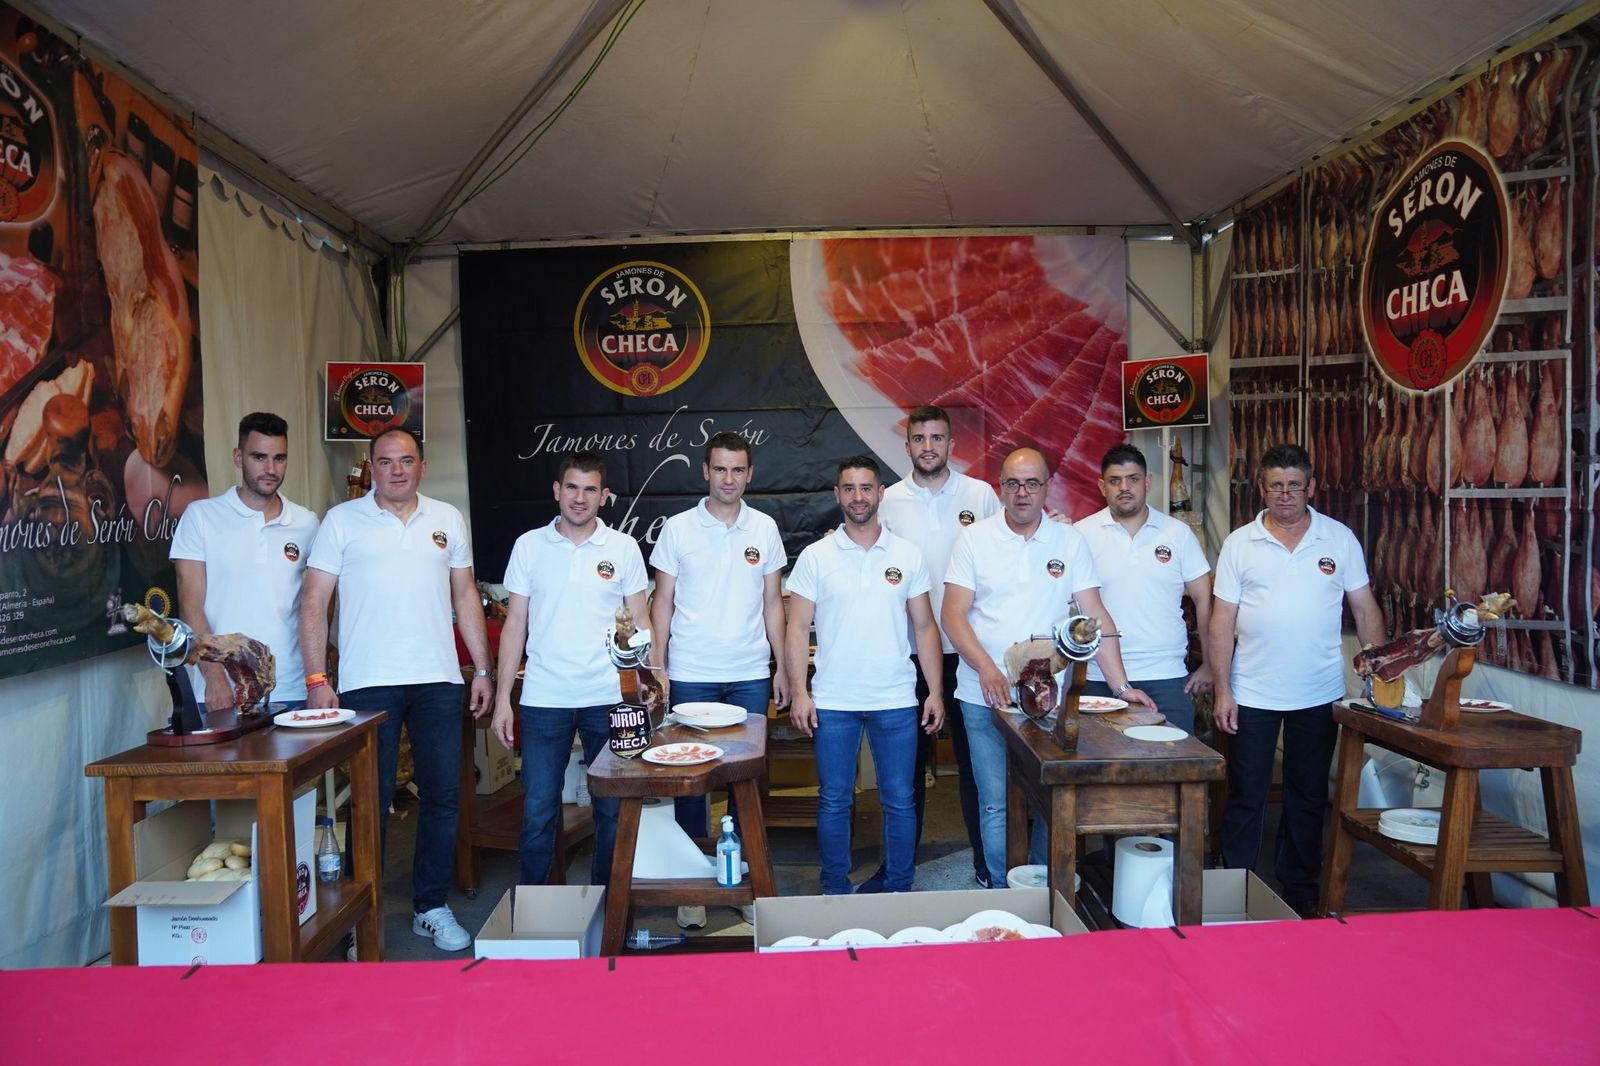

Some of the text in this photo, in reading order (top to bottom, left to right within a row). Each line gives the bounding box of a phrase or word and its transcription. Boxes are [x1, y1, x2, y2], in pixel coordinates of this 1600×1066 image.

[1409, 155, 1458, 190] JAMONES DE
[1388, 171, 1485, 239] SERON
[615, 267, 665, 279] JAMONES DE
[601, 277, 687, 309] SERON
[1386, 270, 1471, 320] CHECA
[601, 333, 679, 354] CHECA
[355, 376, 399, 393] SERON
[1146, 370, 1185, 383] SERON
[354, 404, 394, 415] CHECA
[1147, 394, 1181, 405] CHECA
[518, 405, 771, 460] Jamones de Són
[58, 474, 82, 547] de
[87, 499, 138, 545] Serón
[611, 736, 648, 749] CHECA
